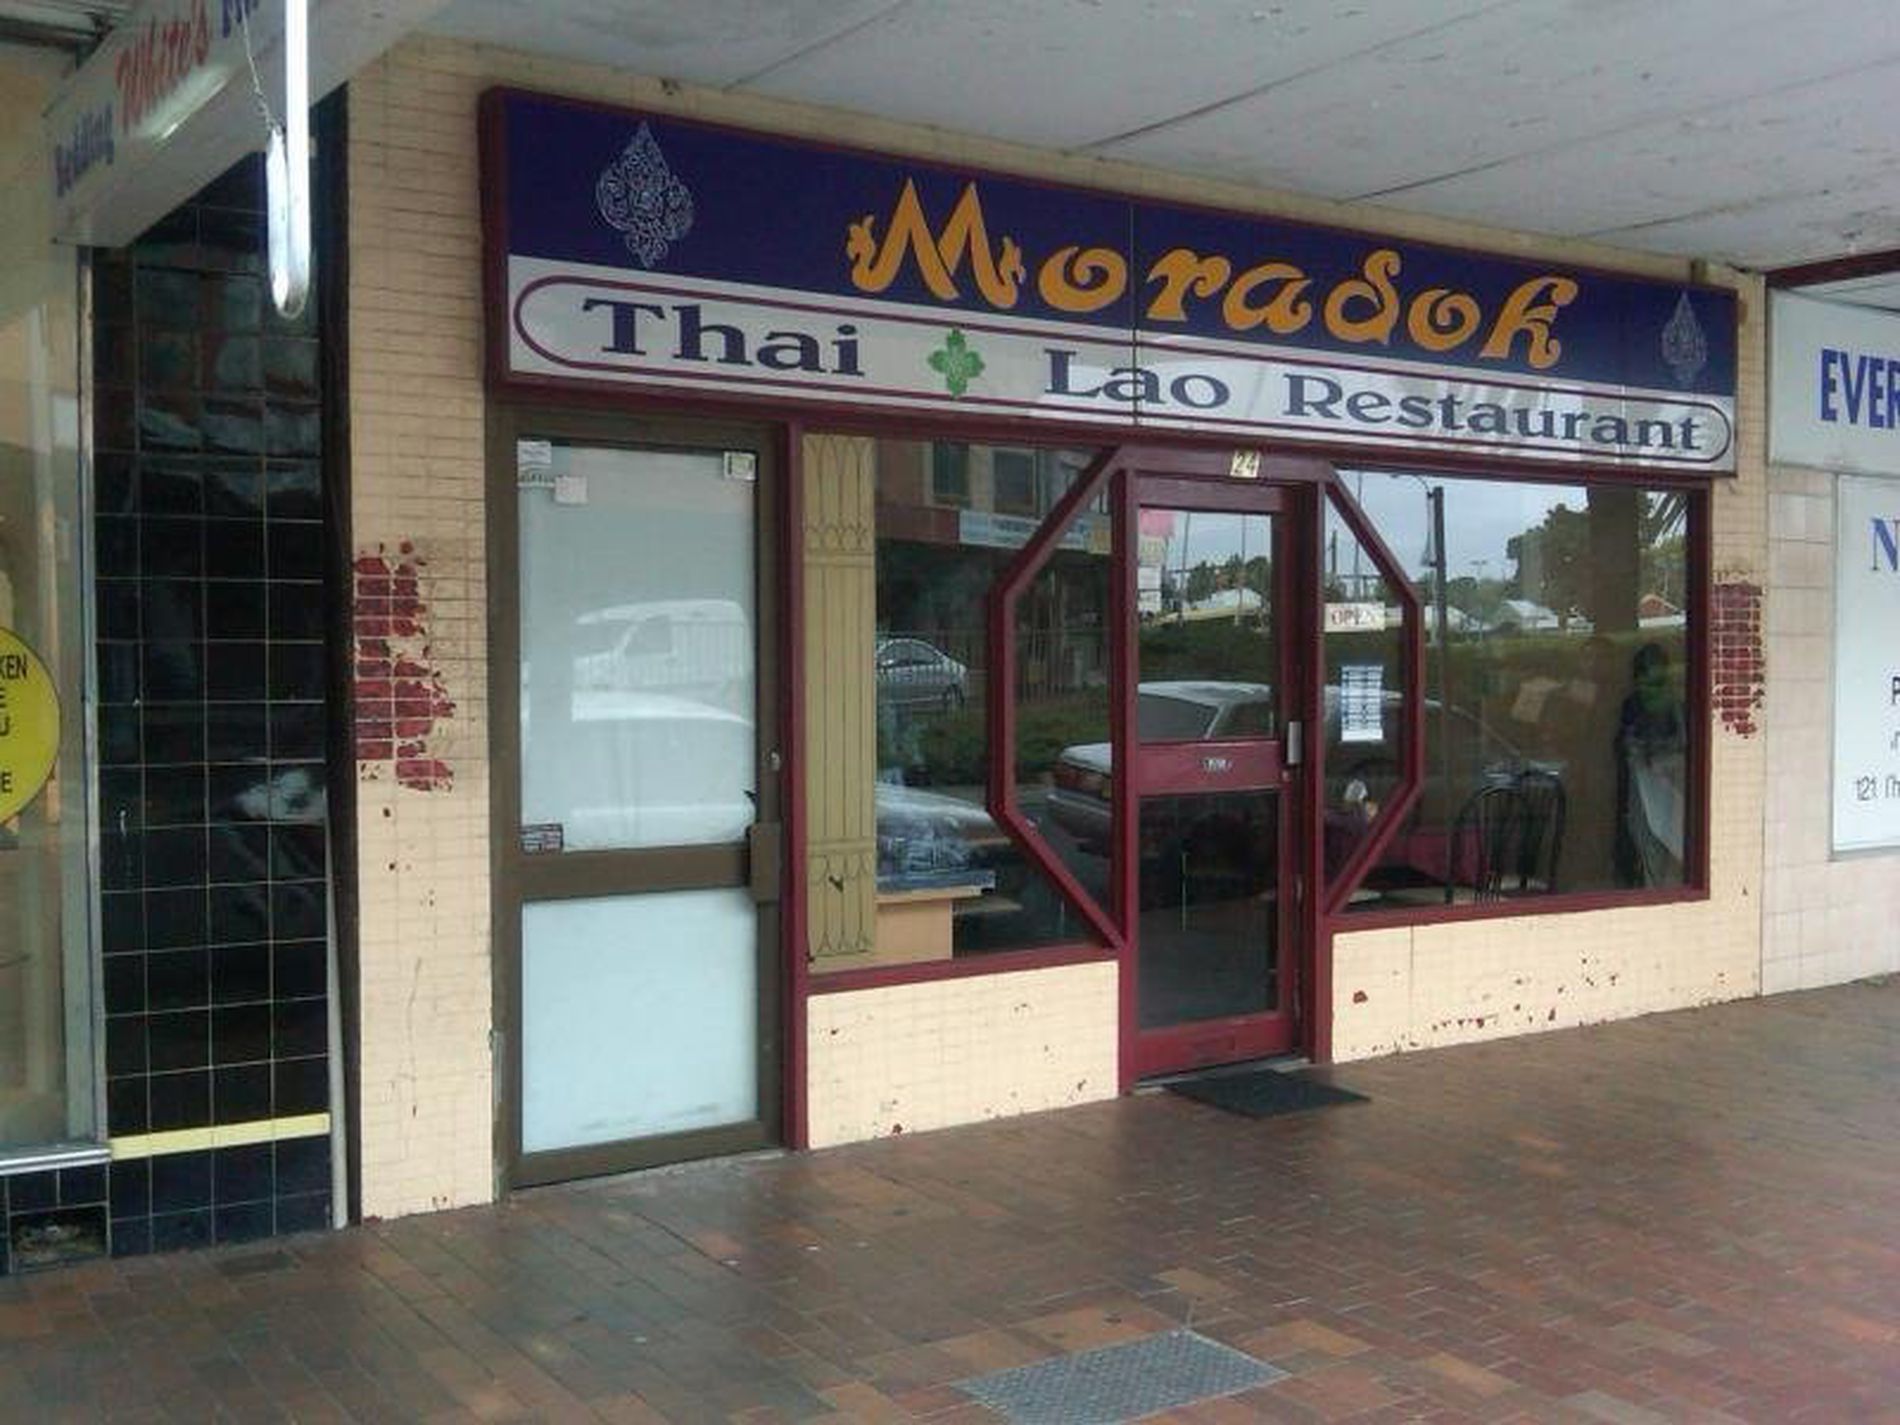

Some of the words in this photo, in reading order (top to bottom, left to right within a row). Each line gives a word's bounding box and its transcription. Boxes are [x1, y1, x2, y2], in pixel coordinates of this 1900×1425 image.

[845, 175, 1579, 369] Moradok
[582, 297, 865, 377] Thai
[1044, 348, 1231, 410] Lao
[1282, 373, 1701, 450] Restaurant
[1233, 451, 1258, 474] 24
